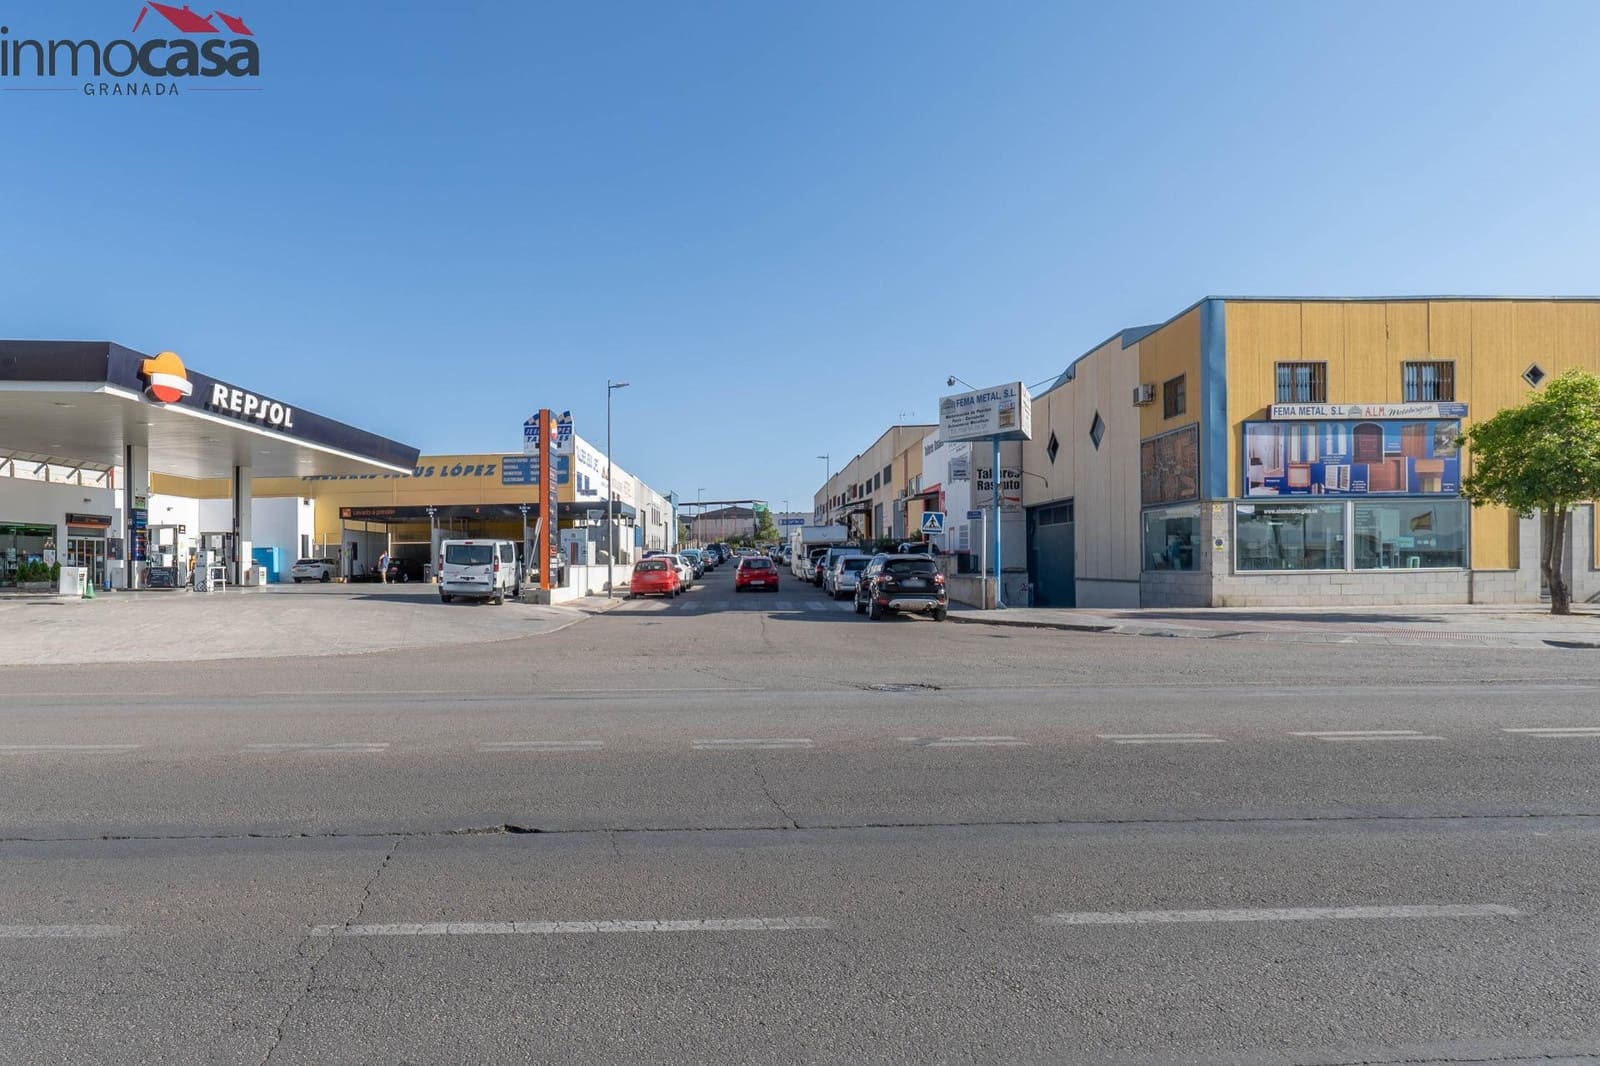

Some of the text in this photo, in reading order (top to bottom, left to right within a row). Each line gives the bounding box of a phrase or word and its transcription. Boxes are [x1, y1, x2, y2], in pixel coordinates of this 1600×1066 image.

[212, 383, 293, 428] REPSOL
[956, 396, 975, 408] FEMA
[1273, 406, 1296, 416] FEMA
[440, 463, 496, 478] LÓPEZ
